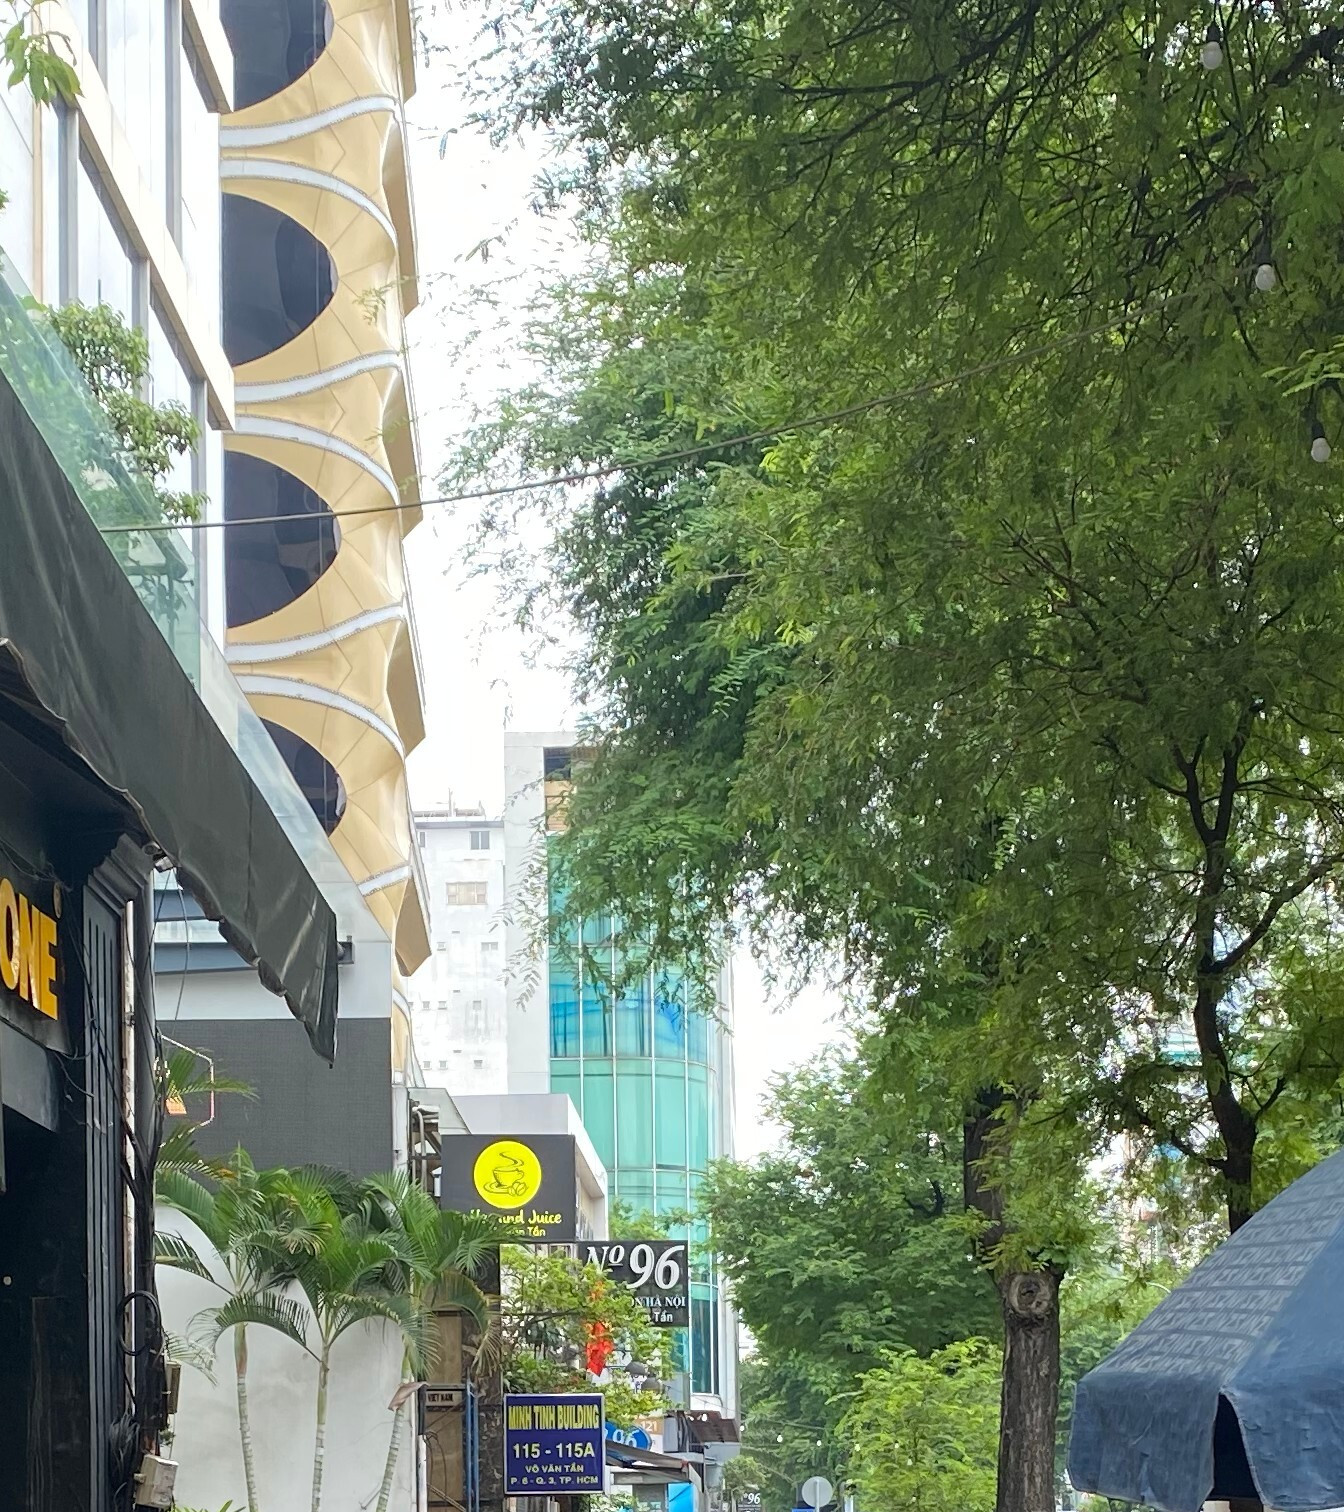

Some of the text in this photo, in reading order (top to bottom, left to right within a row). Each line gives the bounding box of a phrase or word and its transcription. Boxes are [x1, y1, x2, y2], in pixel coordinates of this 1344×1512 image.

[528, 1210, 562, 1224] Juice
[508, 1405, 532, 1430] MINH
[557, 1404, 599, 1430] BUILDING
[513, 1442, 541, 1459] 115
[555, 1442, 595, 1459] 115A
[577, 1475, 599, 1485] HCM
